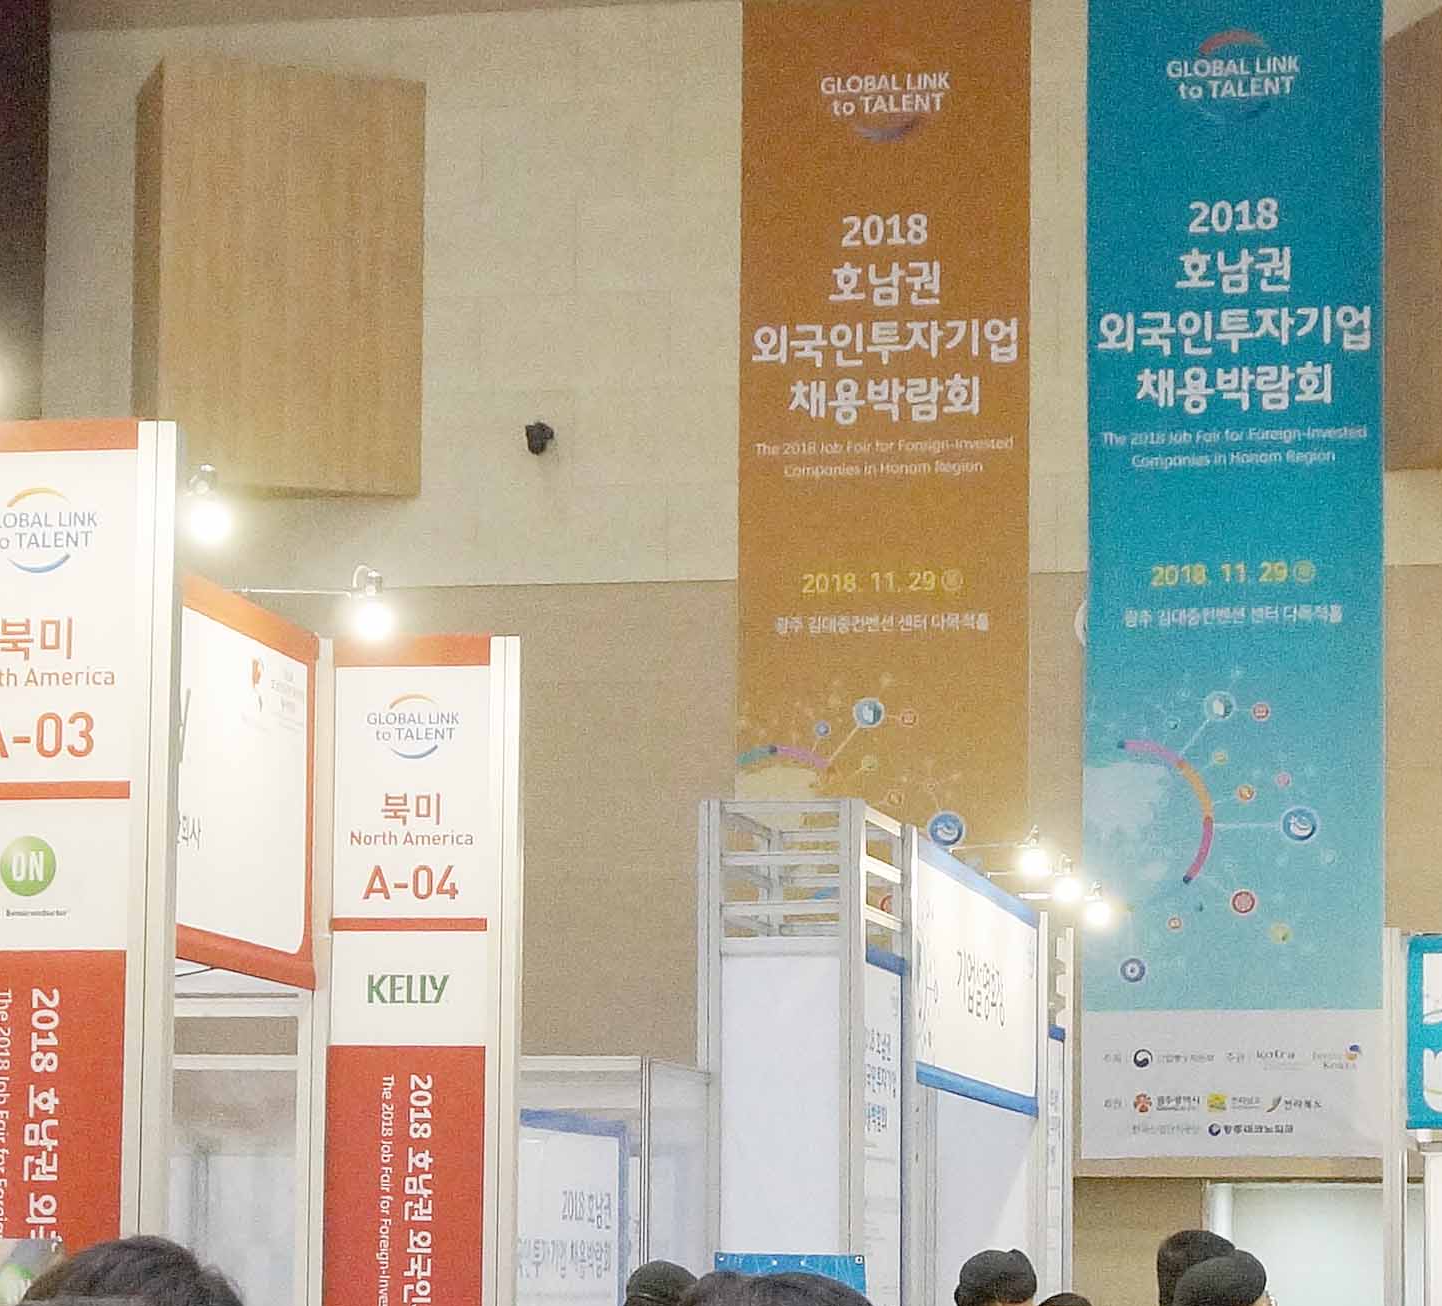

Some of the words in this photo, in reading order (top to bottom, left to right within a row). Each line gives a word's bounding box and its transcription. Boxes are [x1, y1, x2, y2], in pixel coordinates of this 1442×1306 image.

[1166, 57, 1250, 80] GLOBAL
[1255, 55, 1300, 74] LINK
[821, 74, 901, 96] GLOBAL
[906, 72, 950, 90] LINK
[1178, 81, 1203, 101] to
[1208, 77, 1295, 99] TALENT
[832, 98, 855, 116] to
[860, 93, 945, 114] TALENT
[1188, 197, 1278, 234] 2018
[841, 214, 928, 248] 2018
[829, 260, 940, 307] 호남권
[1175, 246, 1291, 294] 호남권
[751, 318, 1019, 368] 외국인투자기업
[1097, 305, 1372, 356] 외국인투자기업
[788, 373, 979, 425] 채용박람회
[1136, 362, 1333, 415] 채용박람회
[756, 442, 779, 457] The
[783, 441, 816, 456] 2018
[58, 511, 97, 528] LINK
[15, 531, 92, 549] TALENT
[25, 666, 115, 687] America
[367, 712, 426, 726] GLOBAL
[428, 712, 459, 725] LINK
[376, 729, 391, 741] to
[395, 728, 455, 742] TALENT
[380, 793, 441, 825] 북미
[350, 831, 397, 846] North
[403, 831, 473, 846] America
[10, 851, 44, 882] ON
[363, 864, 459, 900] A-04
[367, 974, 449, 1003] KELLY
[31, 988, 59, 1073] 2018
[381, 1075, 395, 1100] The
[381, 1104, 394, 1136] 2018
[409, 1074, 432, 1138] 2018
[23, 1085, 59, 1182] 호남권
[380, 1139, 392, 1163] Job
[380, 1167, 393, 1191] Fair
[405, 1147, 433, 1221] 호남권
[379, 1195, 393, 1215] for
